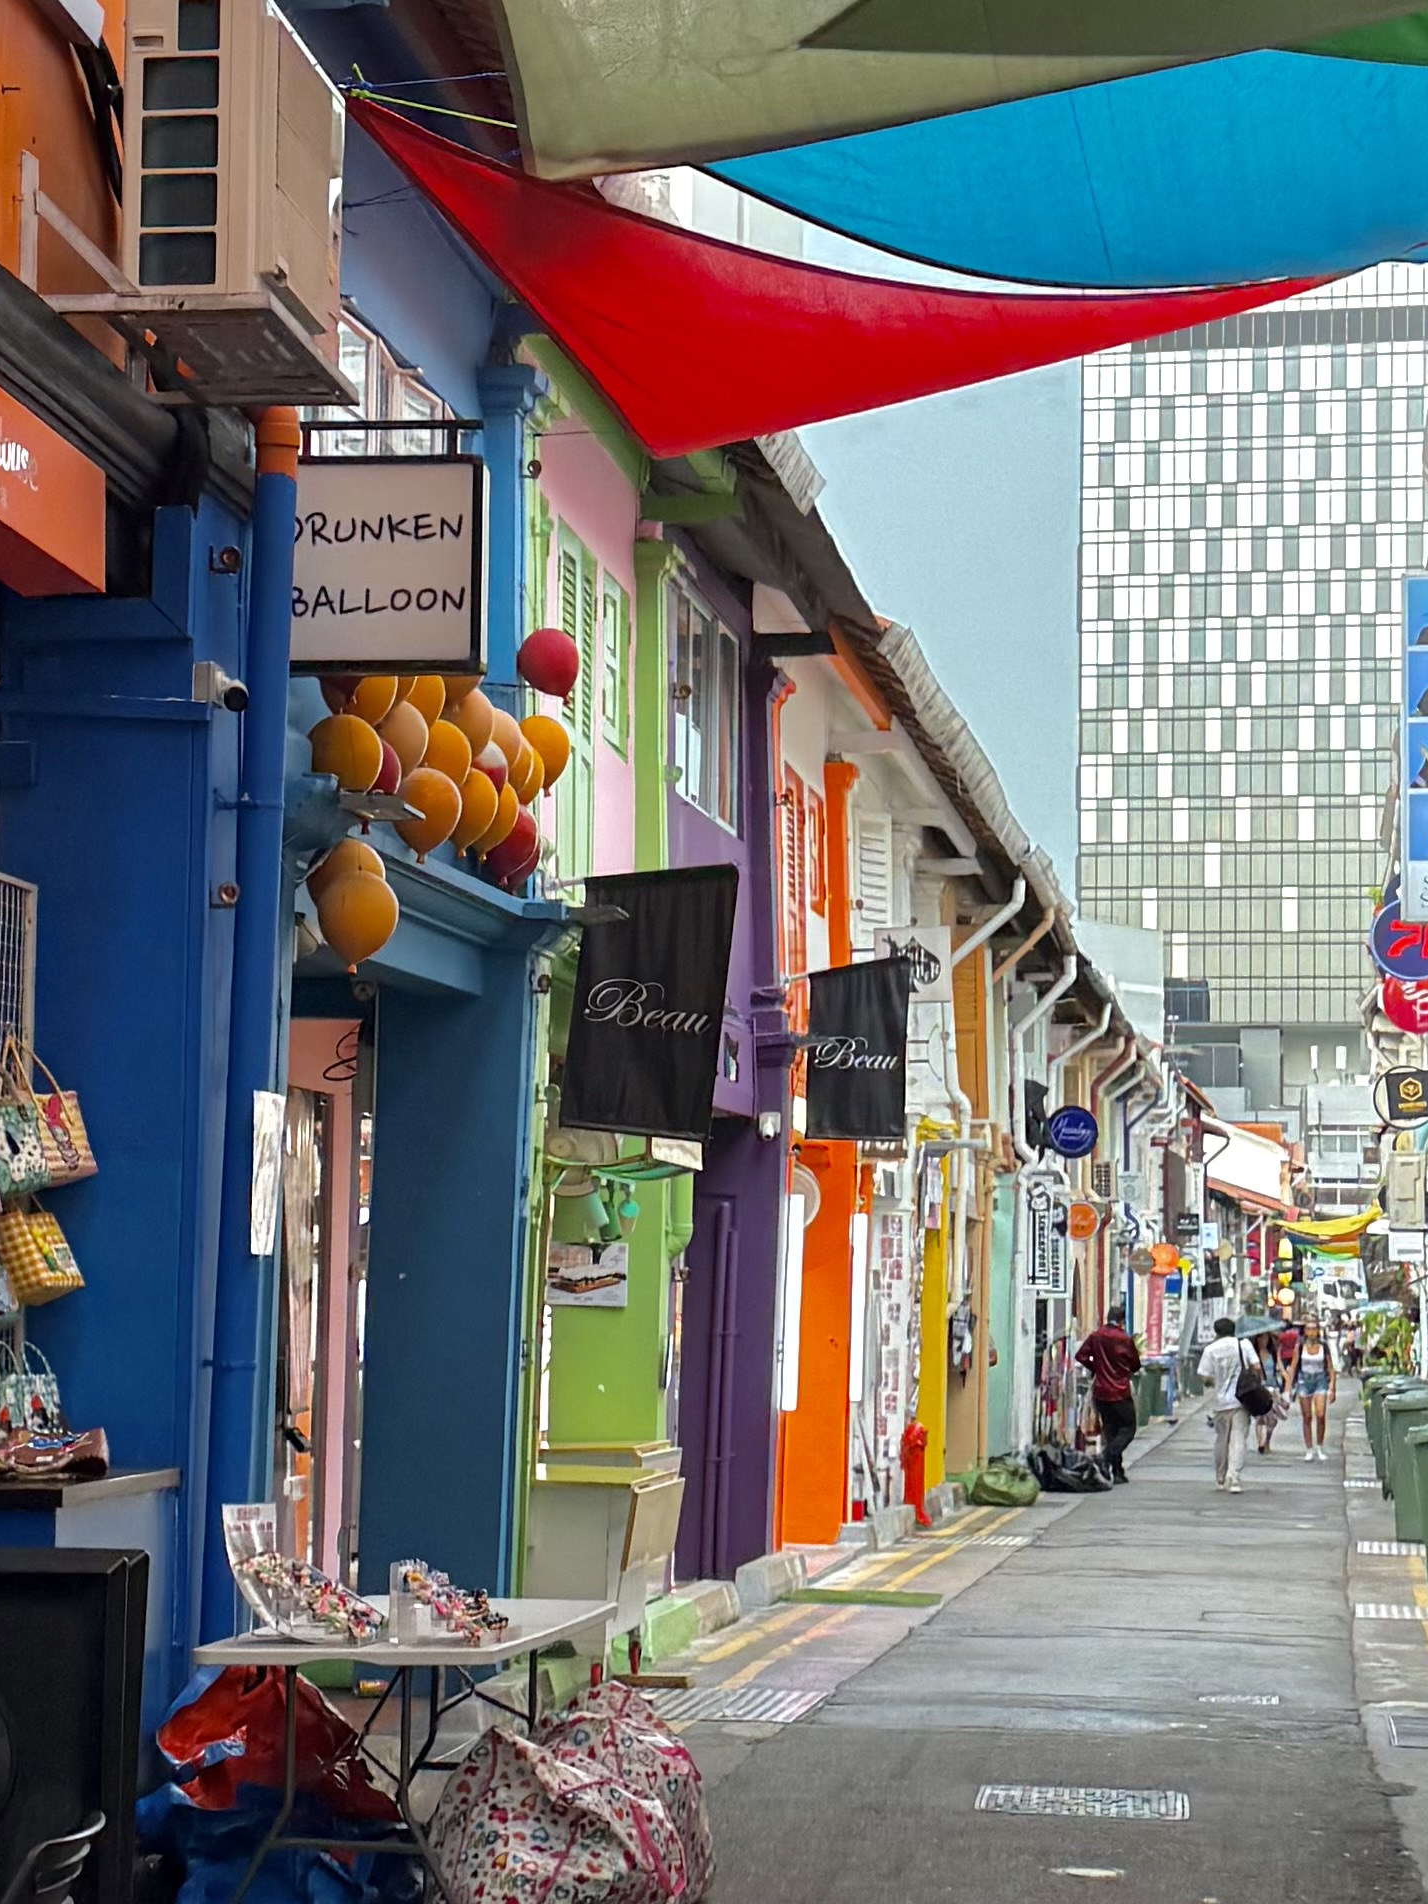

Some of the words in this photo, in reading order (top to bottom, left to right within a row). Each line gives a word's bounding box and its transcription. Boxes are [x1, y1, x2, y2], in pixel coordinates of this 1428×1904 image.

[291, 585, 466, 618] BALLOON
[583, 978, 712, 1036] Beau
[814, 1035, 901, 1071] Beau
